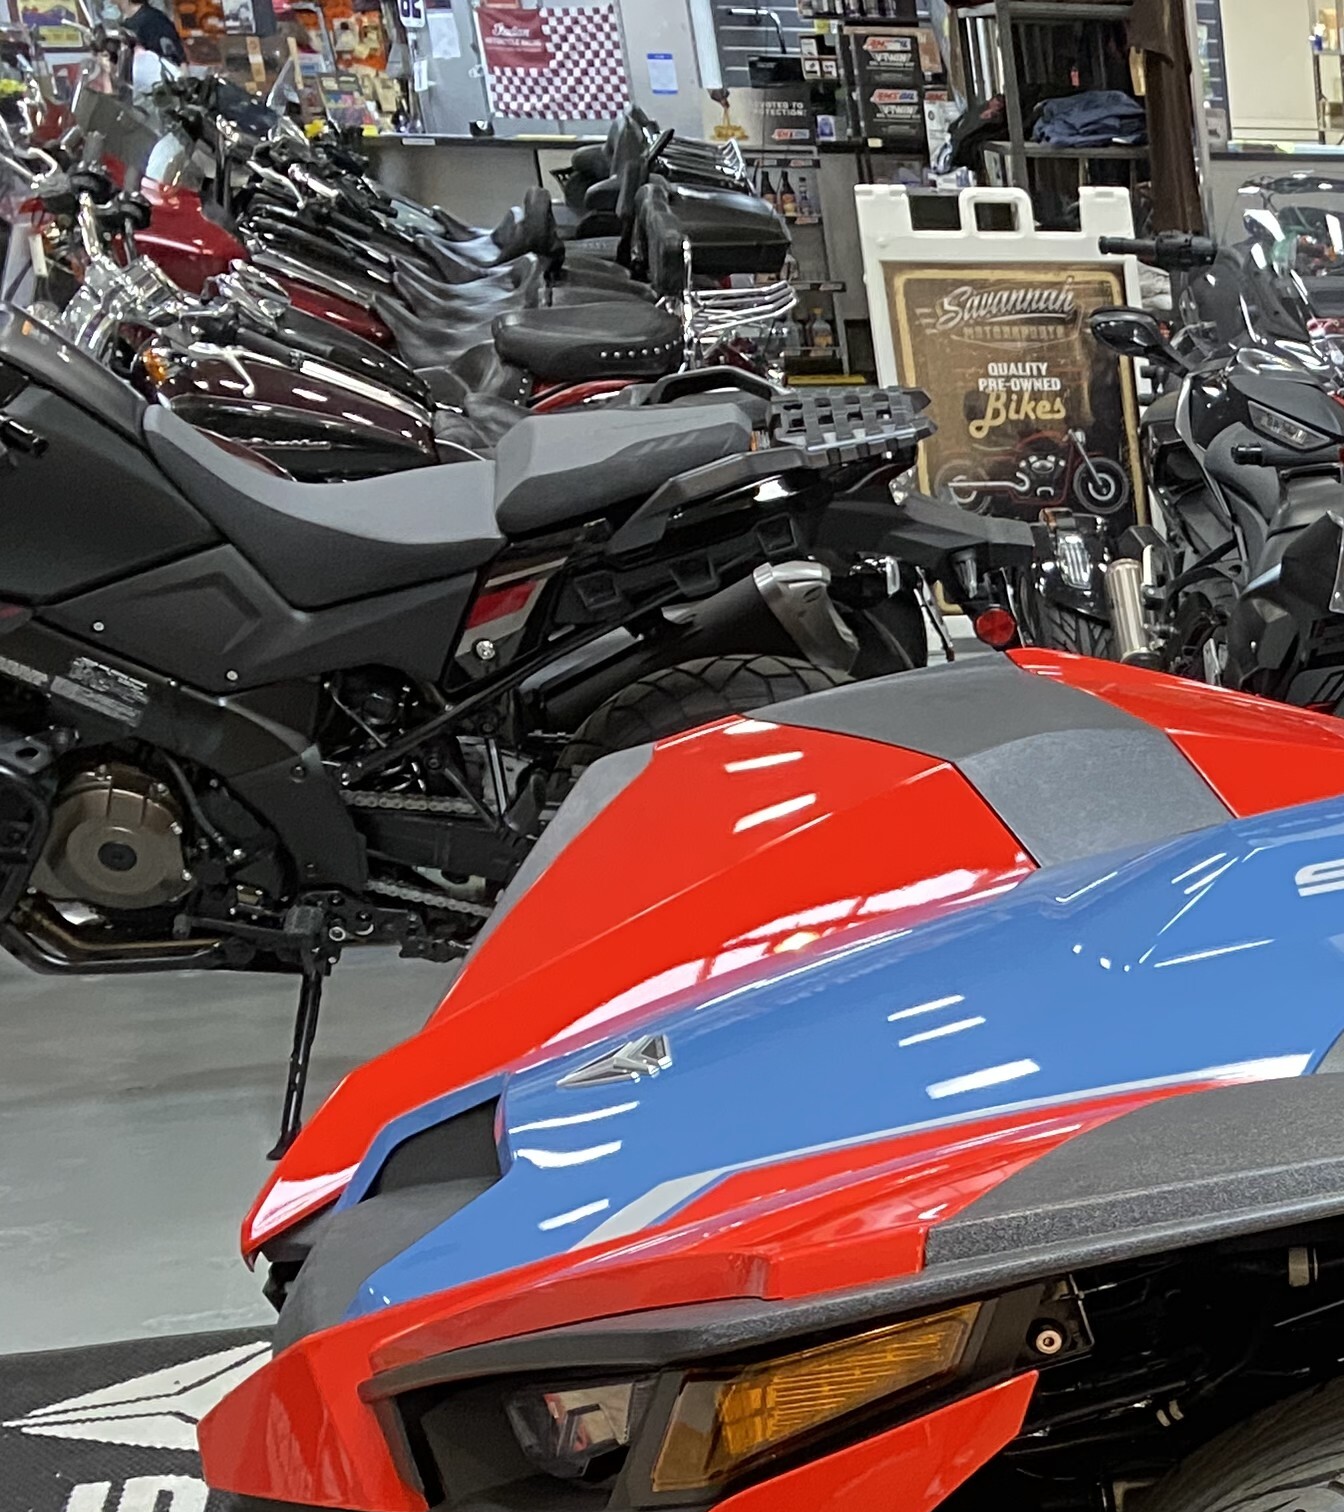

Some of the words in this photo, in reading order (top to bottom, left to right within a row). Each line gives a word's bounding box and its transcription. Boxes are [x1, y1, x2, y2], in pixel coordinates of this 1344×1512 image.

[935, 275, 1075, 330] Savannah
[978, 377, 1062, 392] PRE-OWNED
[987, 361, 1049, 377] QUALITY
[968, 390, 1067, 439] Bikes
